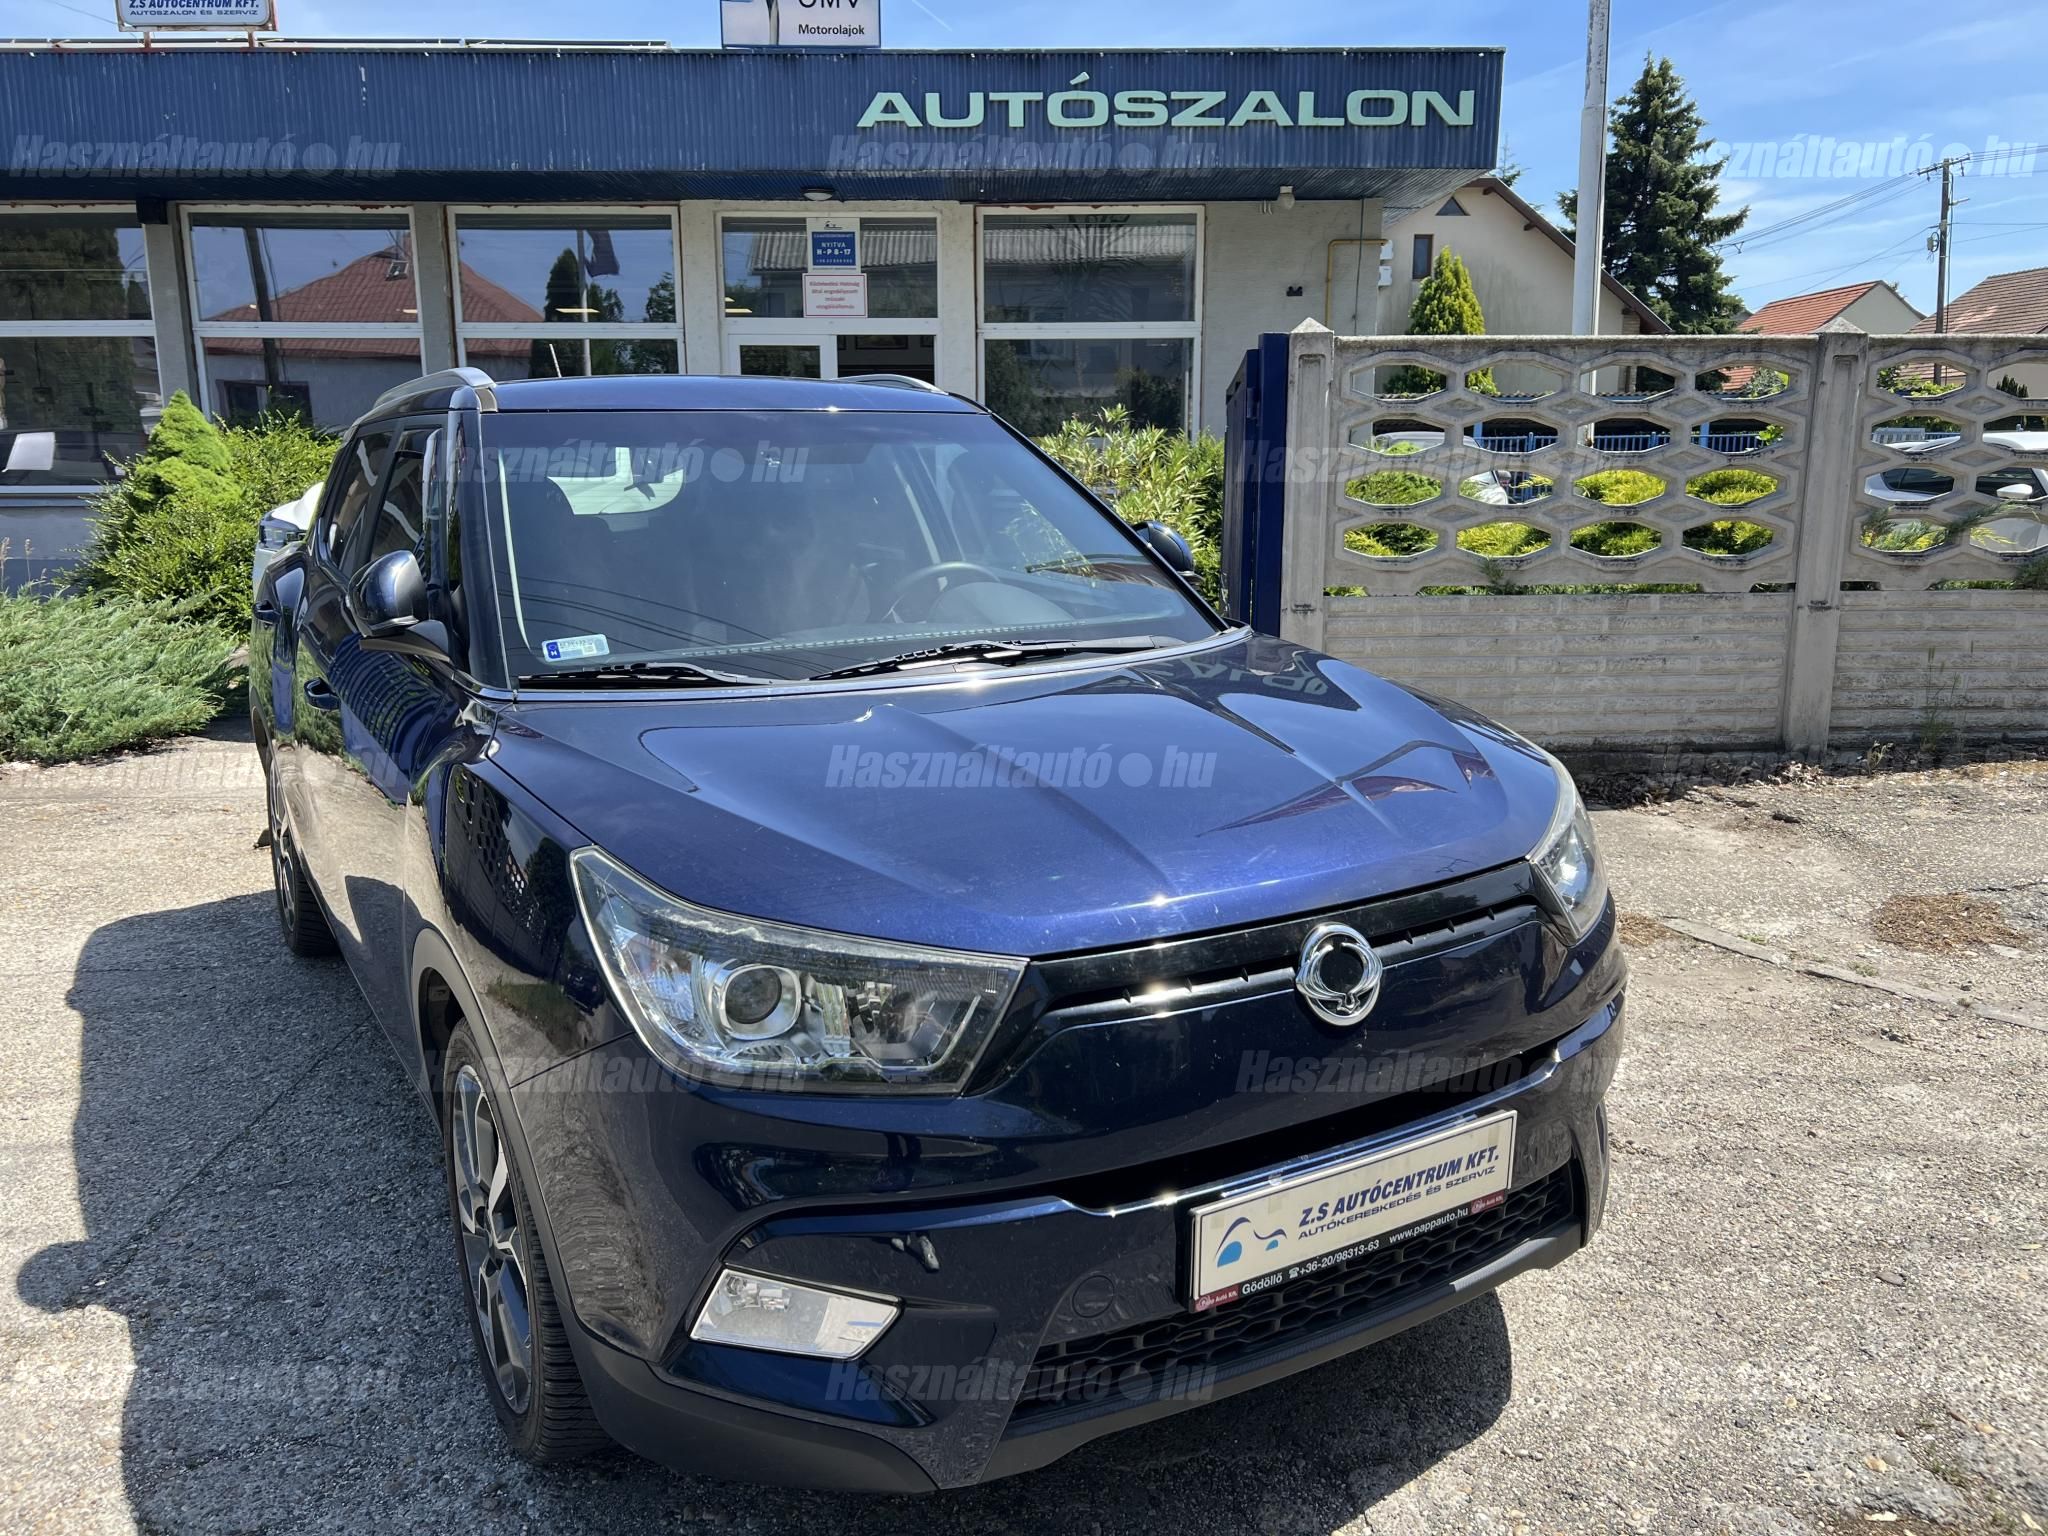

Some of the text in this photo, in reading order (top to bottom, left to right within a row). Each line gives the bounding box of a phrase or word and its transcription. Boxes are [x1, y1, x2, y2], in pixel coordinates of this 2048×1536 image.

[798, 23, 865, 37] Motorolajok
[857, 72, 1475, 129] AUTÓSZALON
[1298, 1145, 1500, 1228] Z.S AUTÓCENTRUM KFT.
[1298, 1166, 1496, 1240] AUTÓKERESKEDÉS ÉS SZERVIZ
[1241, 1271, 1283, 1295] Gödöllő
[1389, 1207, 1469, 1245] www.pappauto.hu
